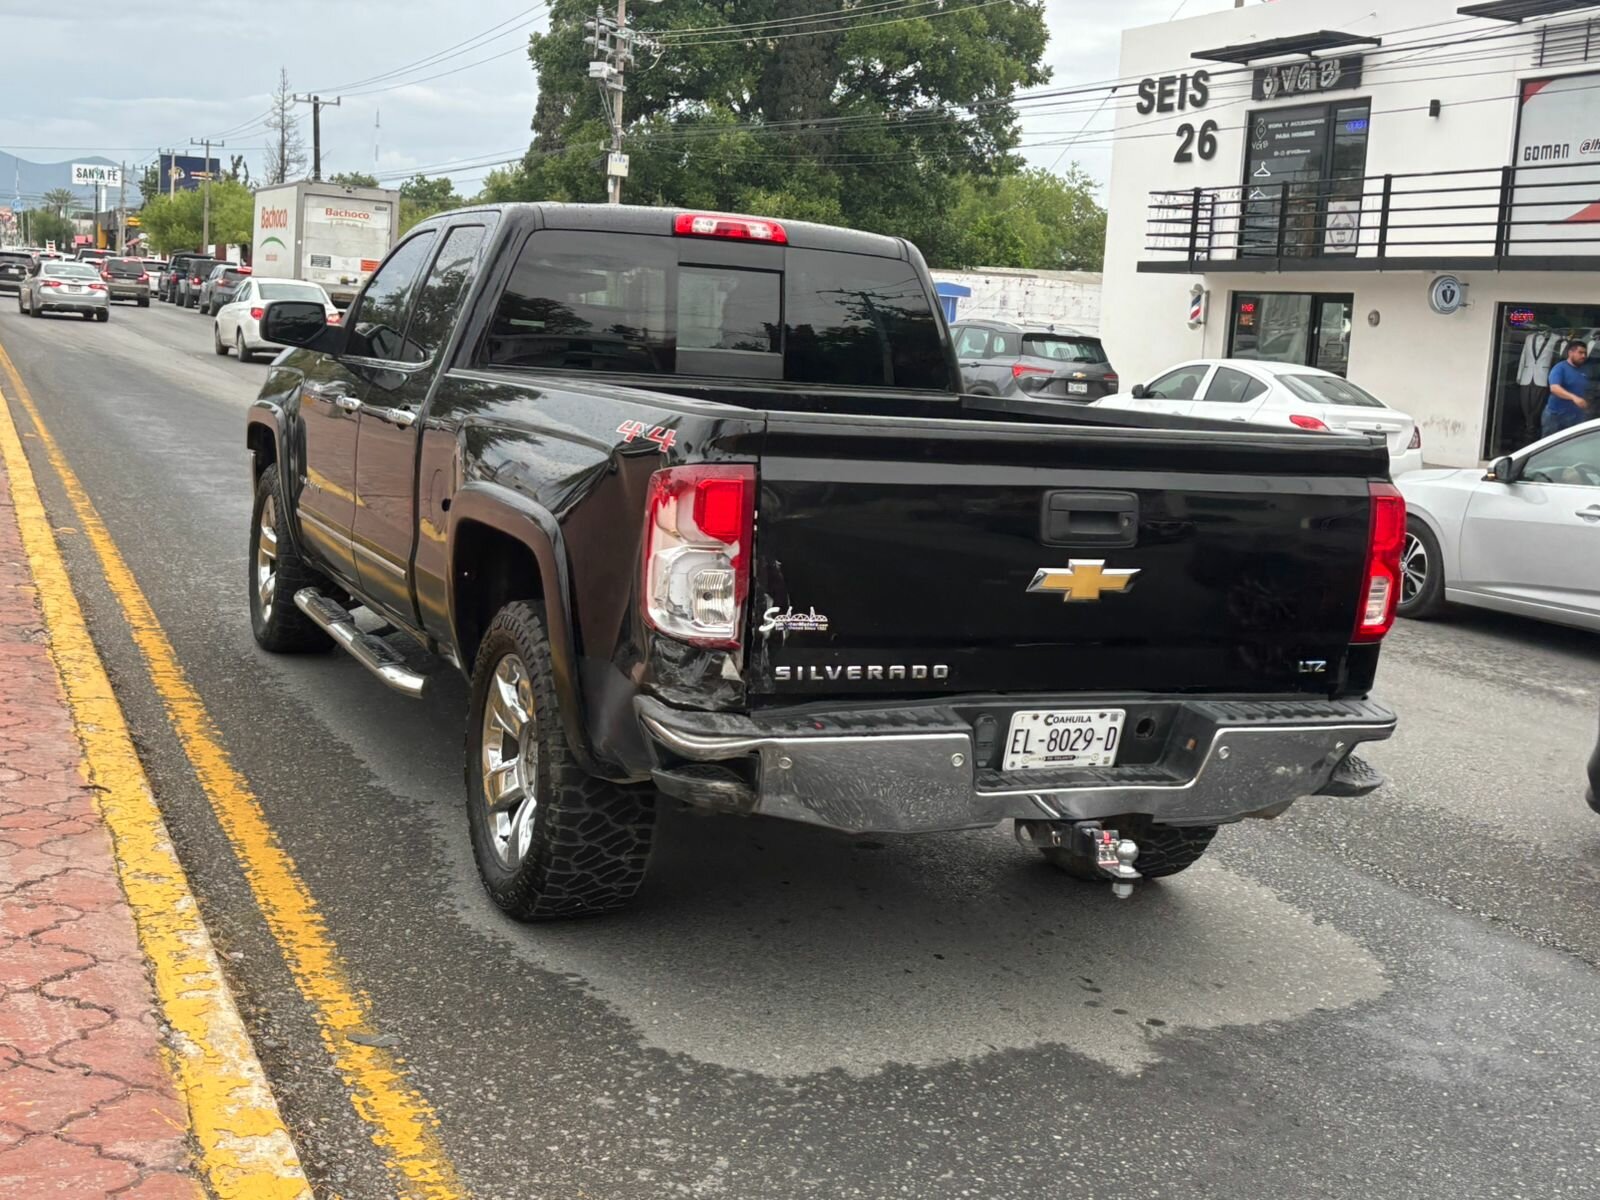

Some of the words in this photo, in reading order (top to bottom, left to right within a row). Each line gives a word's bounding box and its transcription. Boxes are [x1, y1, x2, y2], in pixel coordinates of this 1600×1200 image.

[1281, 60, 1340, 92] VGB
[1136, 69, 1210, 115] SEIS
[1173, 119, 1219, 163] 26
[1524, 143, 1570, 161] GOMAN
[76, 167, 105, 179] SANTA
[107, 170, 118, 181] FE
[261, 205, 288, 230] Bachoco
[325, 207, 370, 220] Bachoco
[774, 664, 949, 681] SILVERADO
[1299, 660, 1327, 673] LTZ
[1044, 714, 1092, 726] COAHUILA
